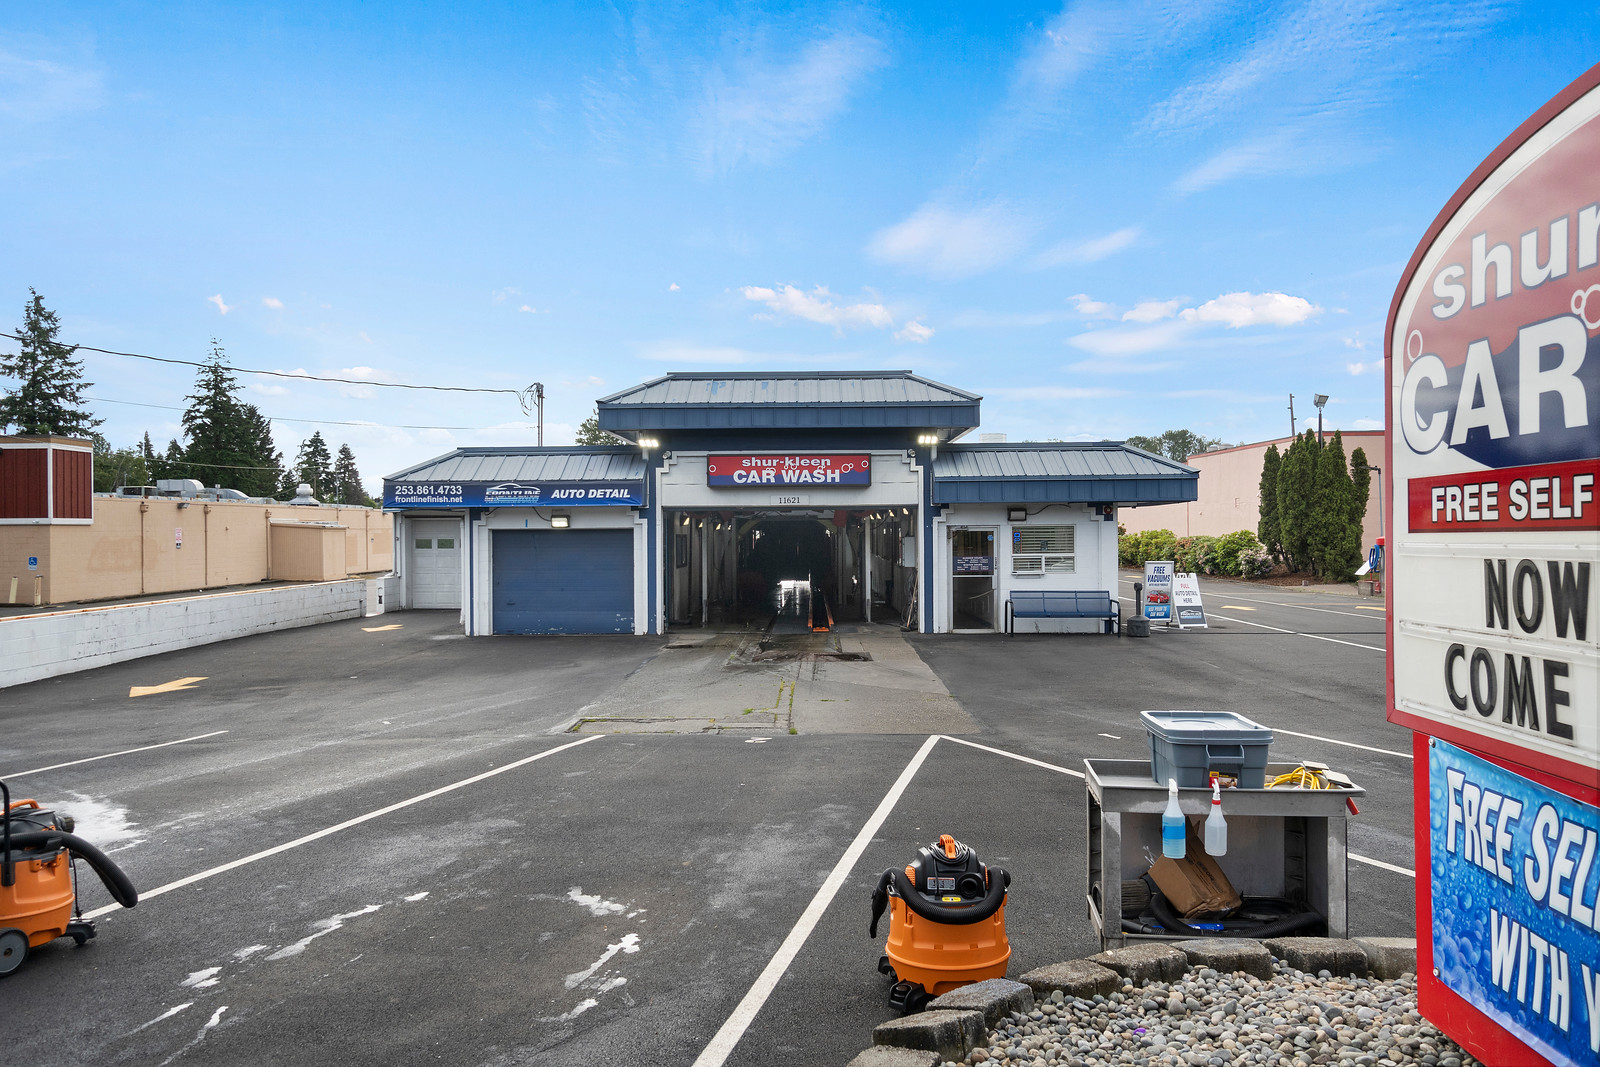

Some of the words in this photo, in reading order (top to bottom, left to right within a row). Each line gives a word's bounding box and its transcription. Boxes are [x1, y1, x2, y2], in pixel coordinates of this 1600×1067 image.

[1400, 312, 1589, 455] CAR
[733, 470, 776, 483] CAR
[781, 469, 840, 483] WASH
[742, 456, 831, 467] shur-kleen
[395, 486, 462, 495] 253.861.4733
[551, 489, 585, 499] AUTO
[588, 488, 631, 498] DETAIL
[395, 495, 463, 503] frontlinefinish.net
[1431, 481, 1499, 523] FREE
[1509, 473, 1595, 521] SELF
[1153, 566, 1166, 574] FREE
[1484, 558, 1590, 641] NOW
[1444, 642, 1573, 740] COME
[1446, 767, 1523, 890] FREE
[1489, 907, 1571, 1036] WITH
